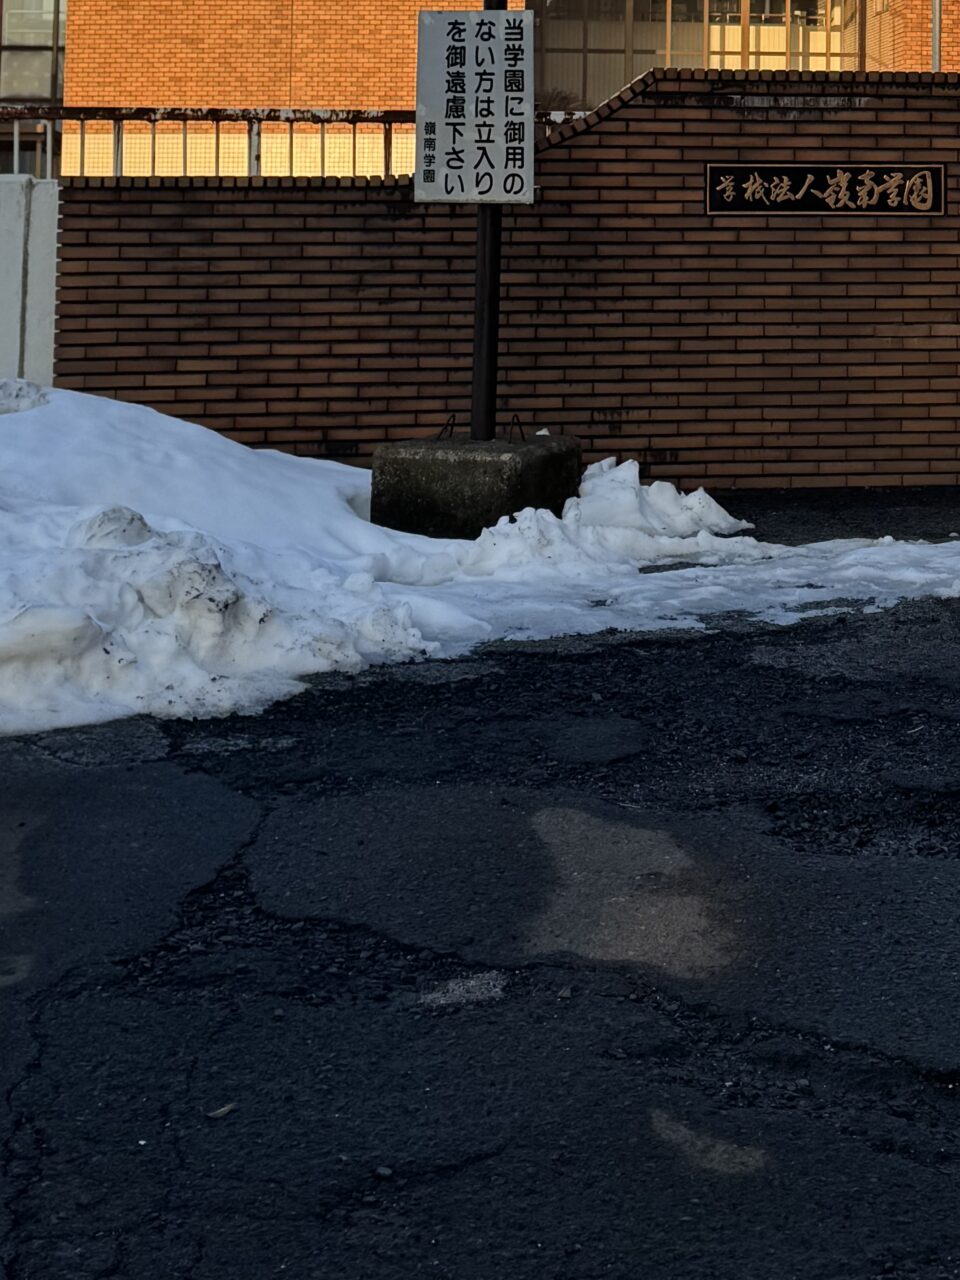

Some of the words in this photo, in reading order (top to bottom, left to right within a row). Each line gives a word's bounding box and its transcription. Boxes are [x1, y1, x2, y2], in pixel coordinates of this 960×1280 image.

[423, 121, 436, 183] 嶺南学園
[445, 19, 467, 196] を御遠慮下さい
[473, 18, 496, 196] ない方は立入り
[503, 18, 525, 196] 当学園に御用の
